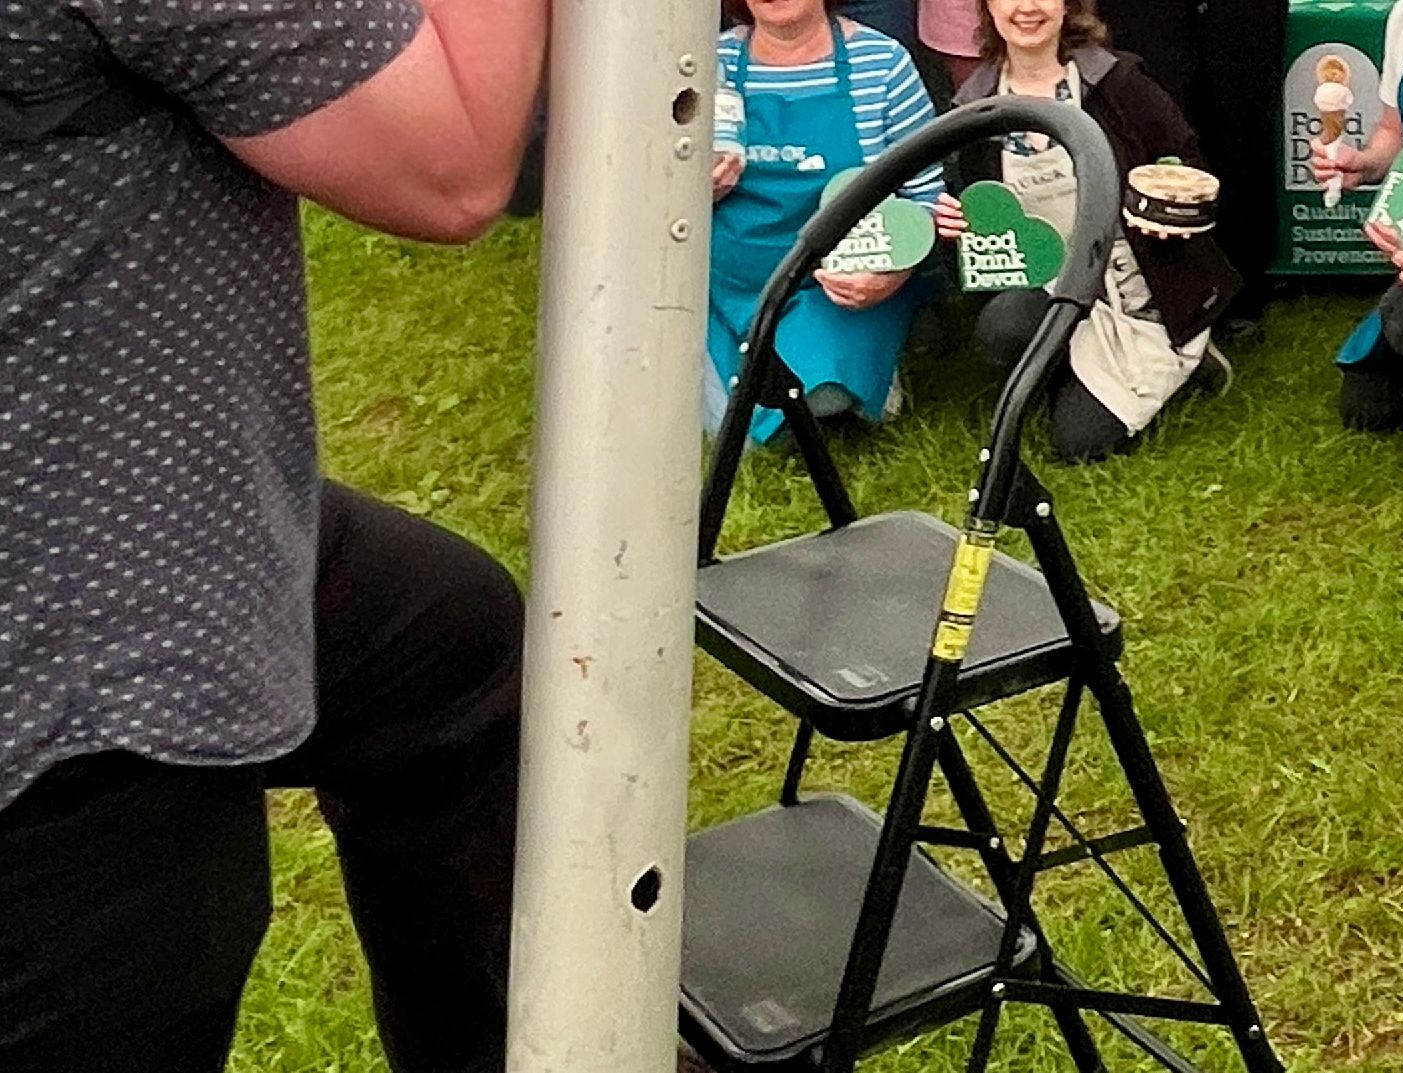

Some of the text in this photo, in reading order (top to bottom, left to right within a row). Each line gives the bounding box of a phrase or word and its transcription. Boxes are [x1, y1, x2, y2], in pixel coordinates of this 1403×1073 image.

[1291, 111, 1365, 135] Fod
[961, 230, 1018, 252] Food
[827, 254, 894, 273] Devon
[962, 248, 1028, 271] Drink
[964, 270, 1029, 288] Devon
